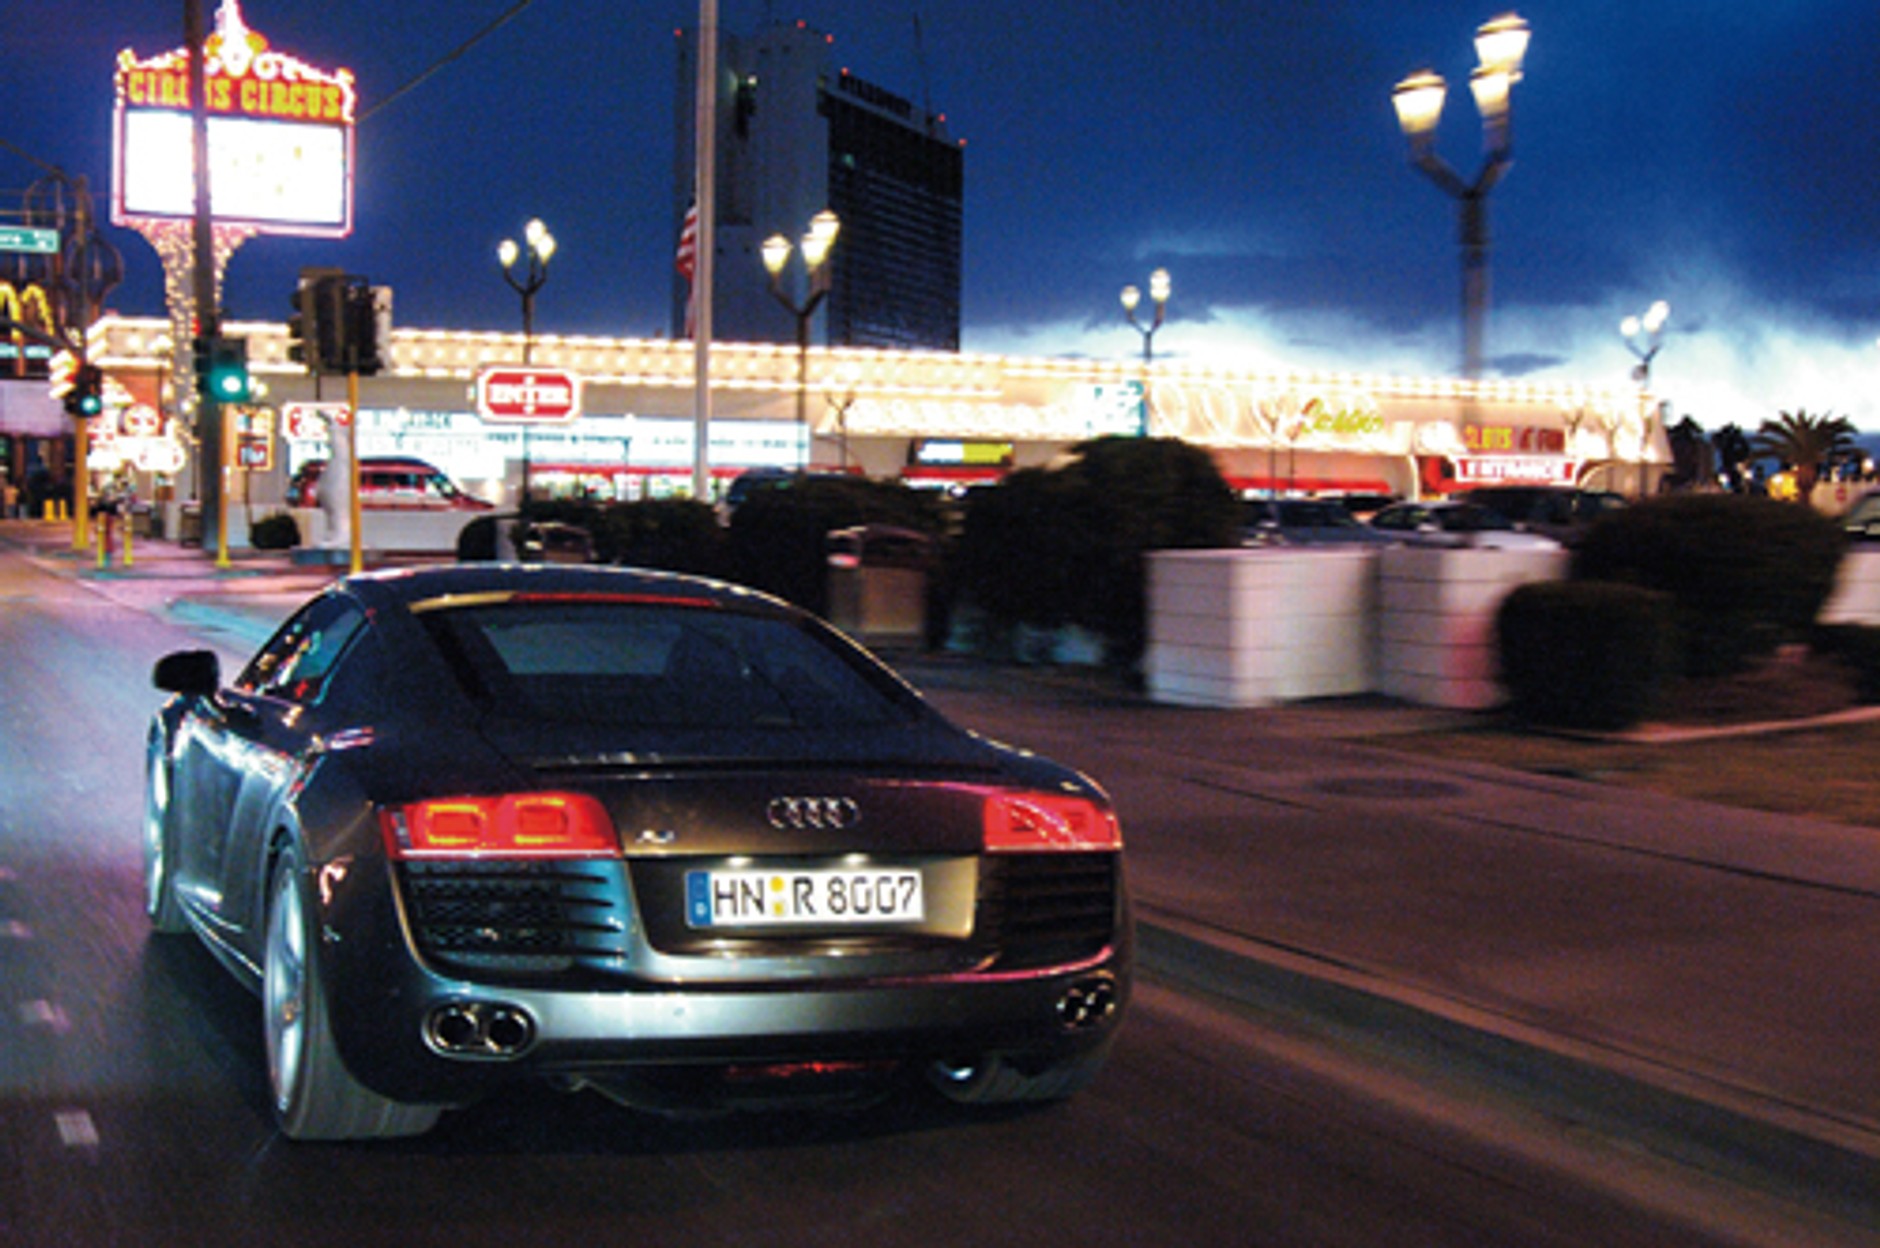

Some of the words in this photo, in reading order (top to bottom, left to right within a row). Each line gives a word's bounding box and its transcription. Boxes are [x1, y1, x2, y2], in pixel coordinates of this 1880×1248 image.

[128, 71, 231, 109] CIRS
[241, 79, 341, 118] CIRCUS
[487, 384, 571, 405] ENTER
[713, 877, 765, 916] HN
[792, 876, 817, 914] R
[826, 874, 918, 915] 8007
